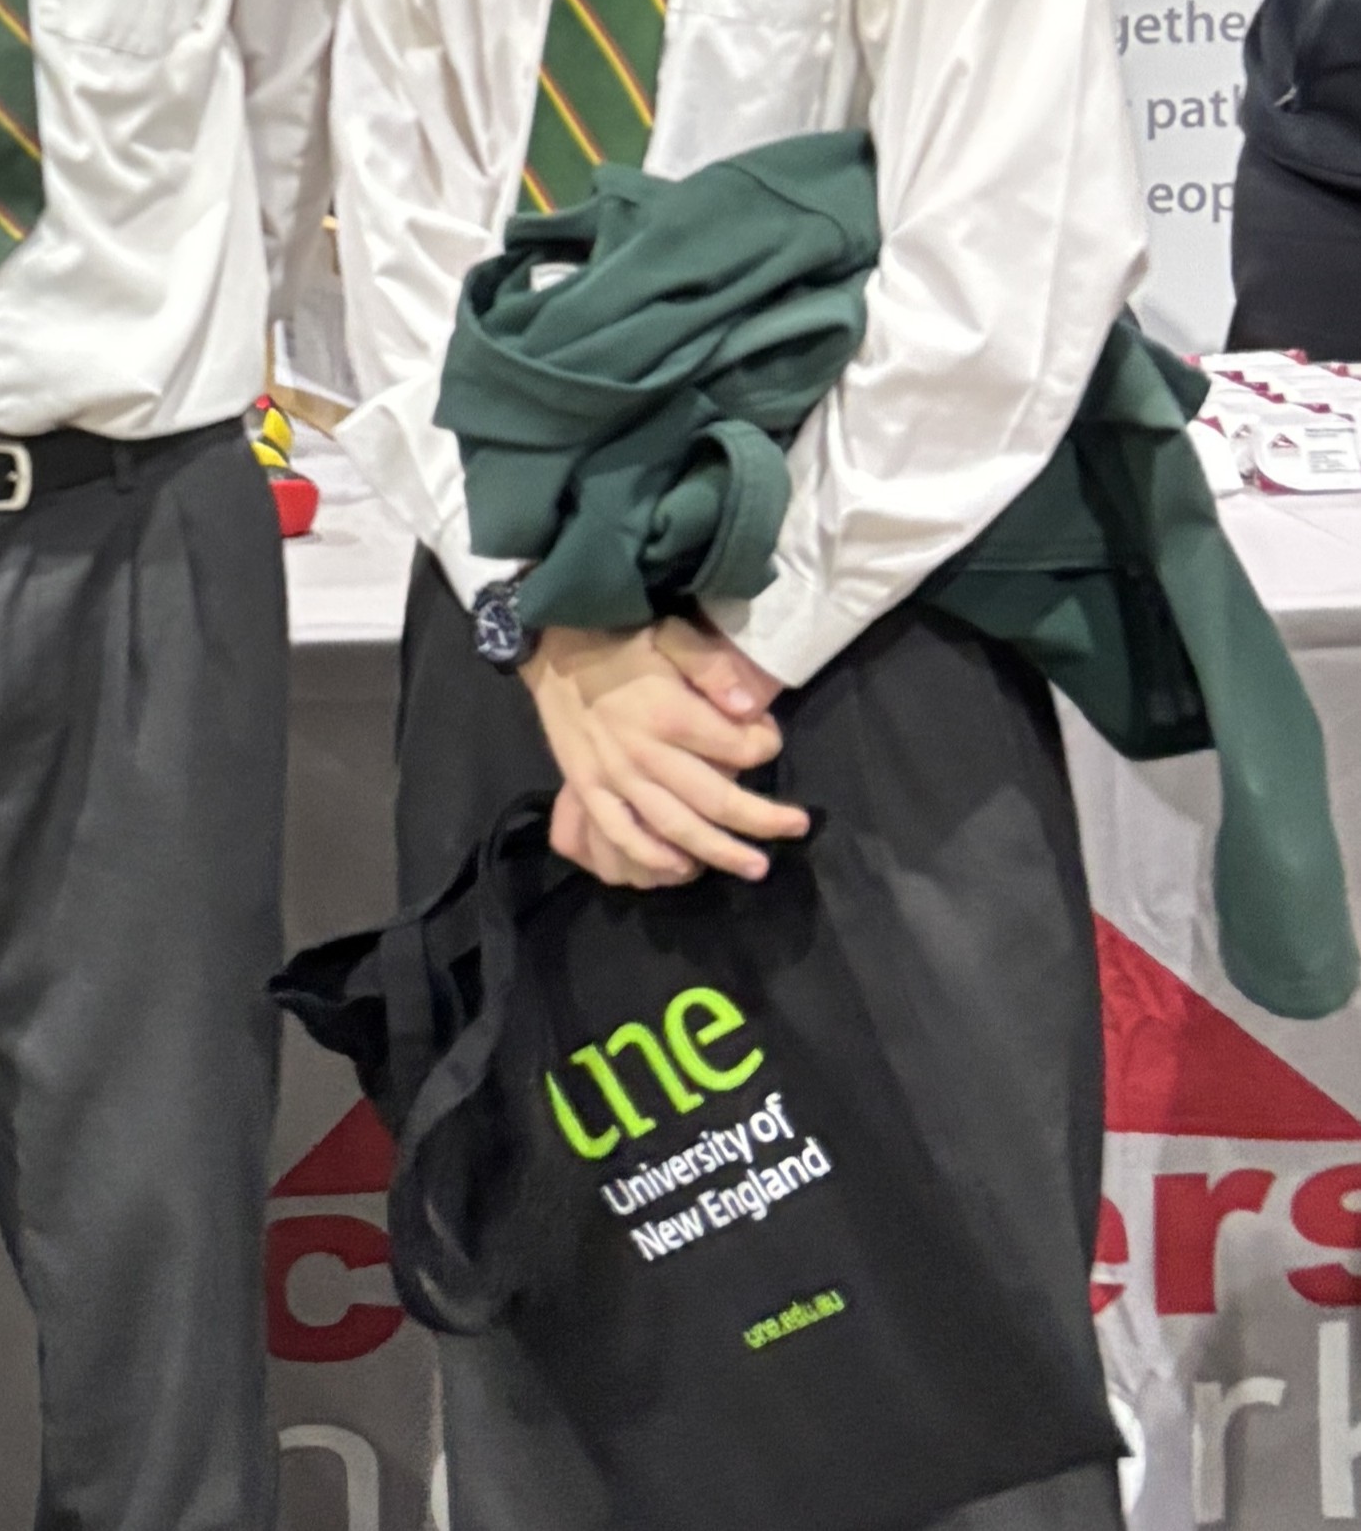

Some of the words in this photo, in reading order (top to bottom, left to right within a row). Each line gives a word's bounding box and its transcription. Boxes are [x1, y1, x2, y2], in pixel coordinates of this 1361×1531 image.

[1147, 181, 1234, 224] eop
[545, 986, 766, 1160] une
[599, 1121, 754, 1216] University
[748, 1091, 795, 1140] of
[629, 1207, 705, 1262] New
[697, 1135, 832, 1221] England
